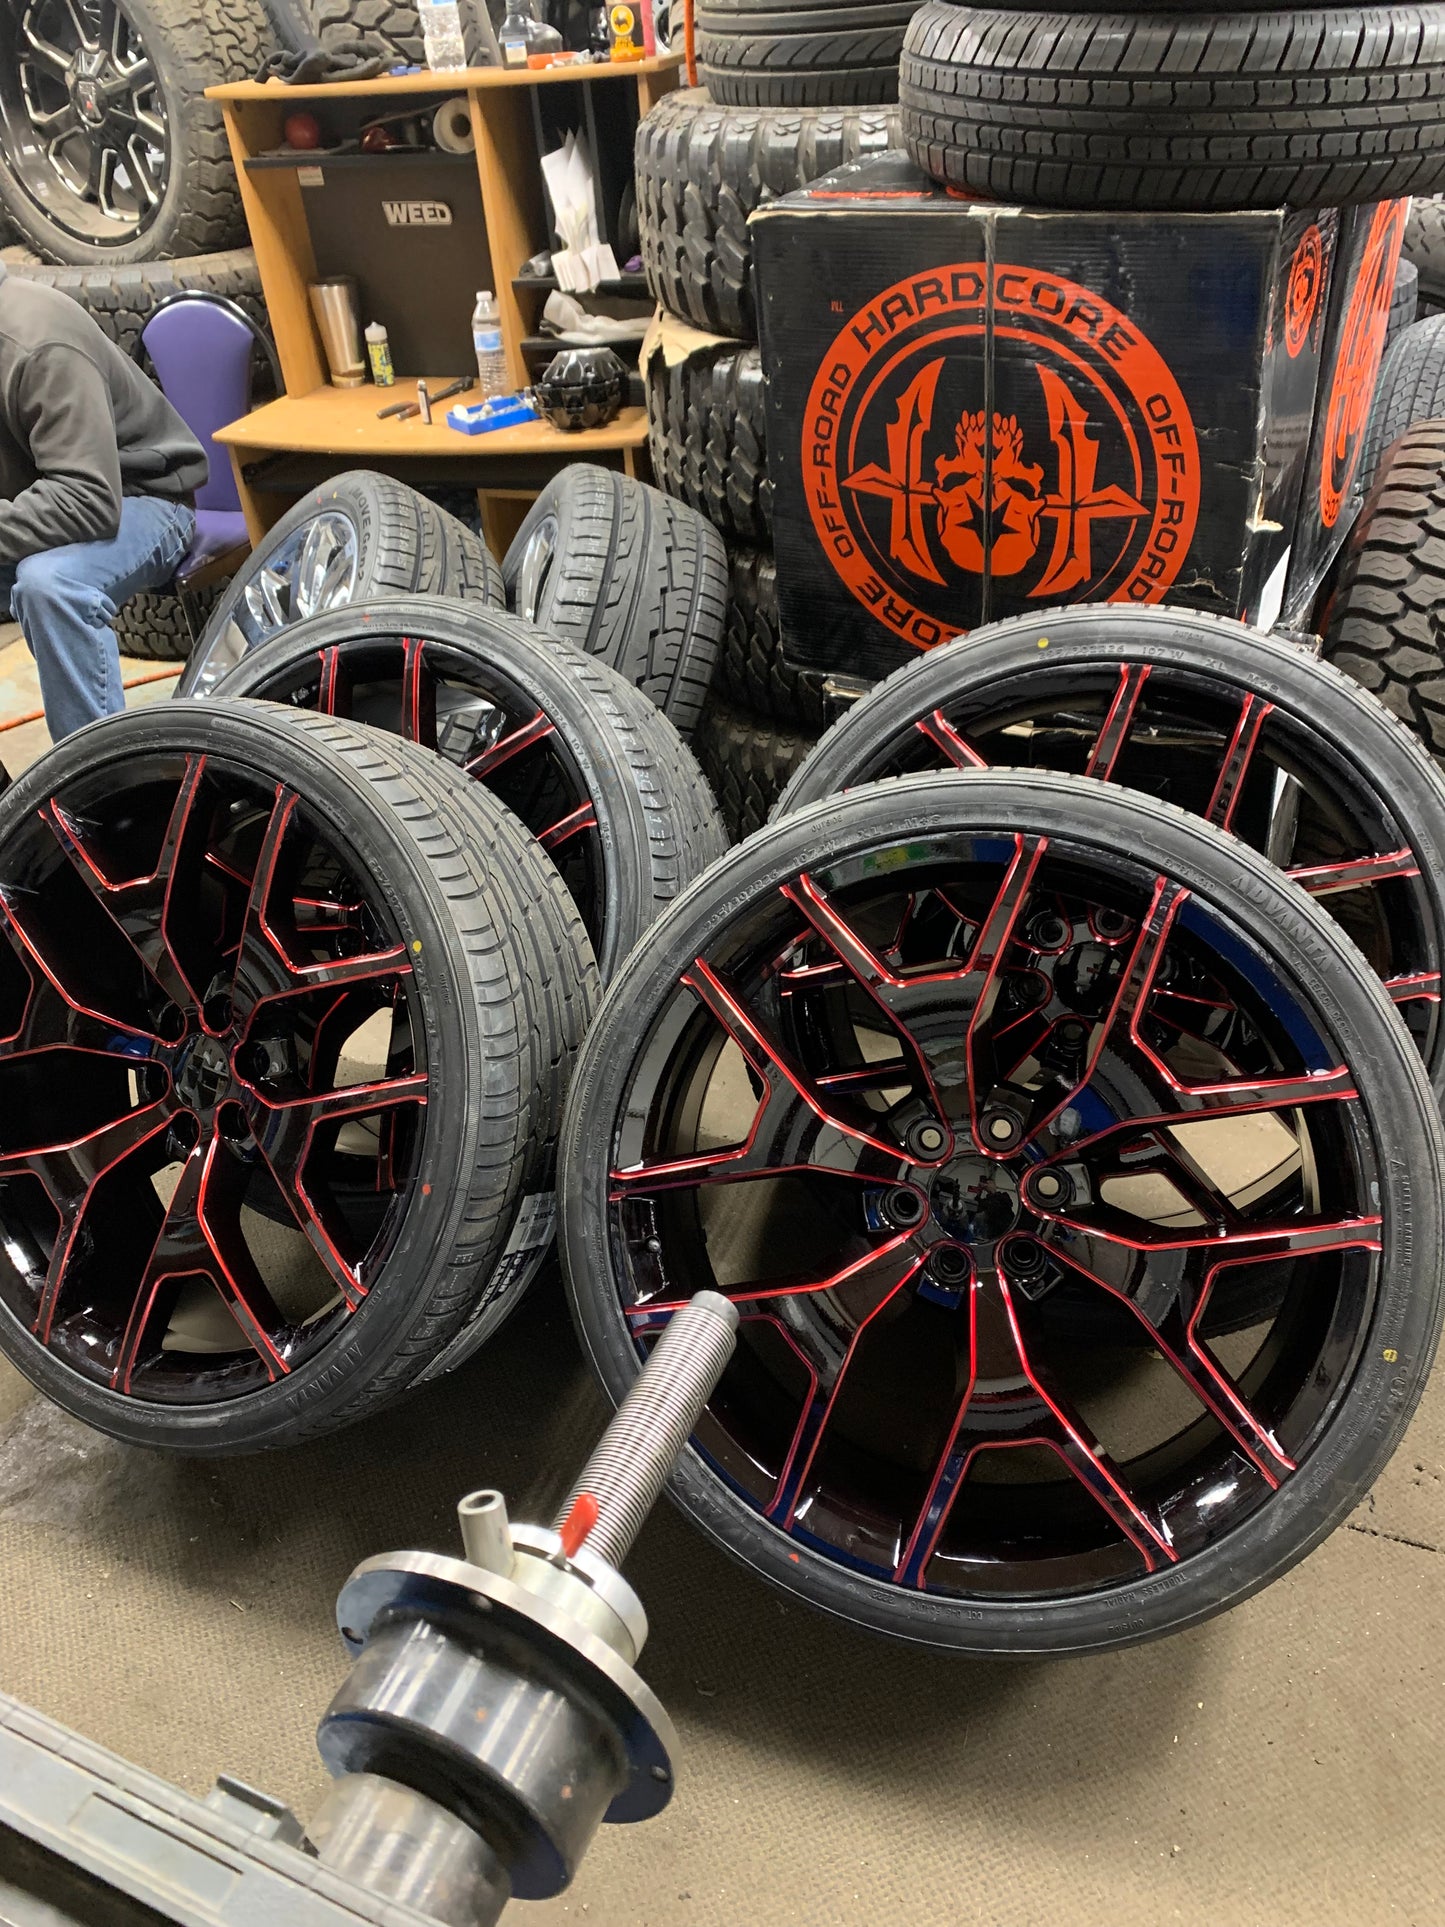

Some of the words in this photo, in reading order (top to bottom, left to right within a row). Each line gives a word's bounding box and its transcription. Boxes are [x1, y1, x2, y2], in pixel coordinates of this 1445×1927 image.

[382, 201, 452, 226] WEED
[812, 362, 854, 559] OFF-ROAD
[1127, 392, 1187, 602] OFF-ROAD
[1206, 656, 1227, 673] XL
[1228, 873, 1331, 973] ADVANTA
